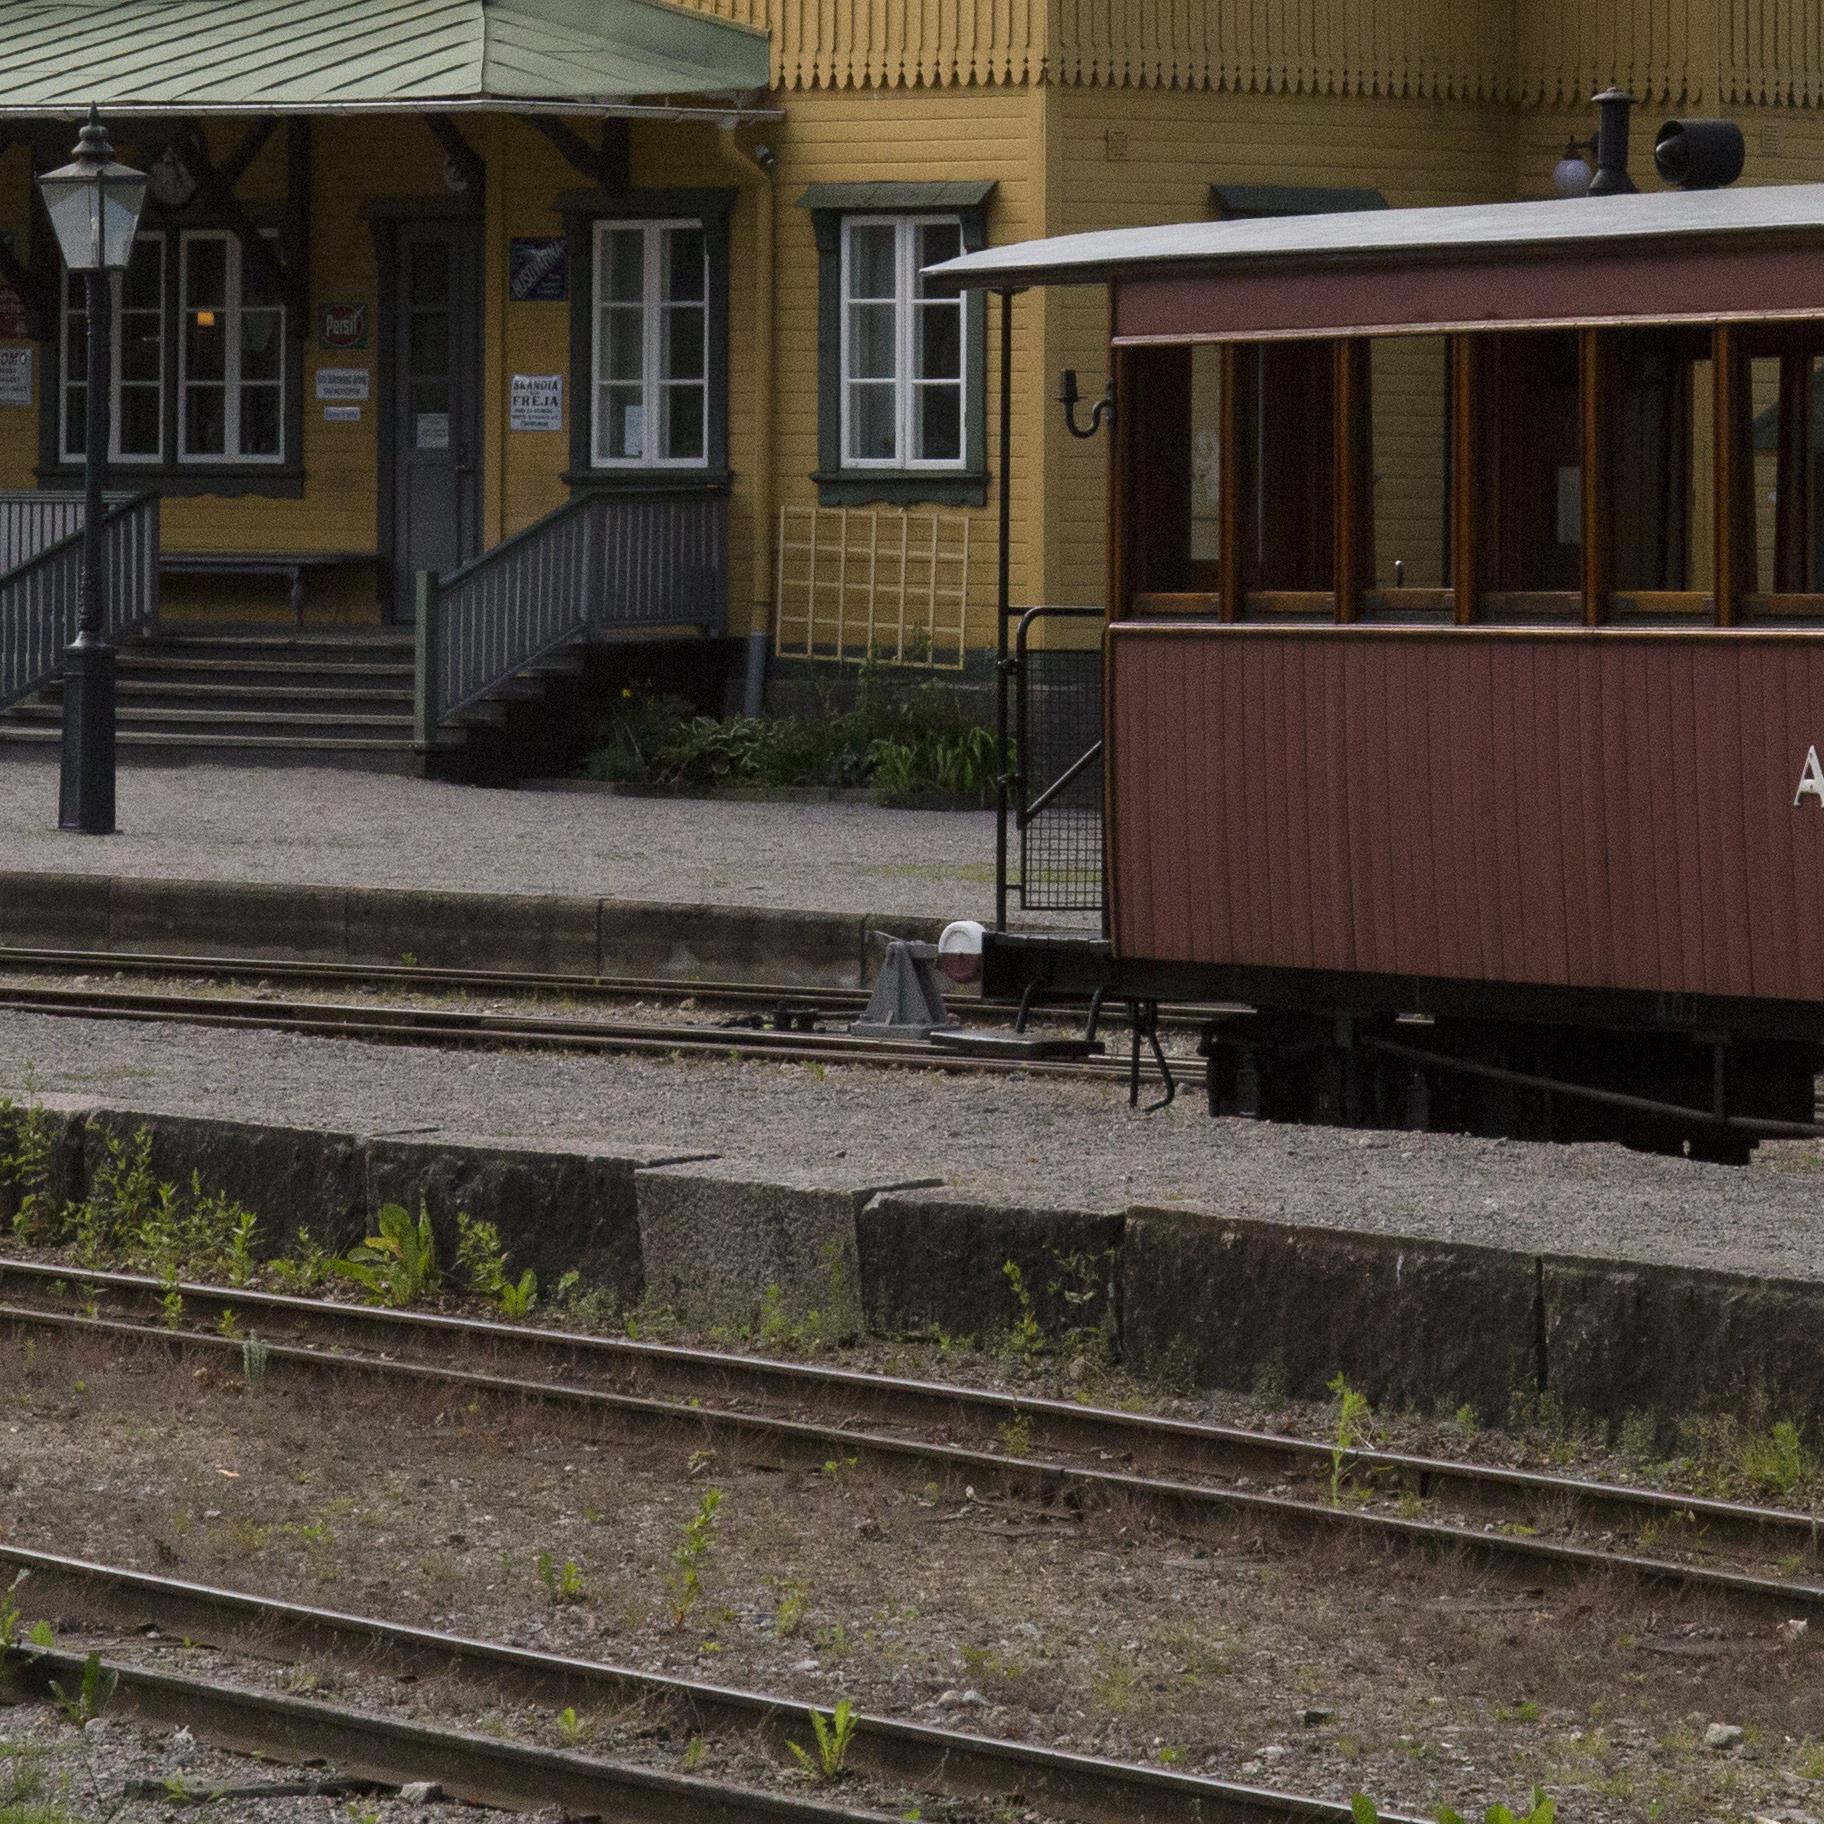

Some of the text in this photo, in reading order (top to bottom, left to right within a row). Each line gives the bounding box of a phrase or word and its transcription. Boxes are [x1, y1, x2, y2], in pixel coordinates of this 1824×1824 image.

[326, 313, 358, 337] Persil
[513, 379, 559, 391] SKANDIA
[512, 395, 559, 407] FREJA
